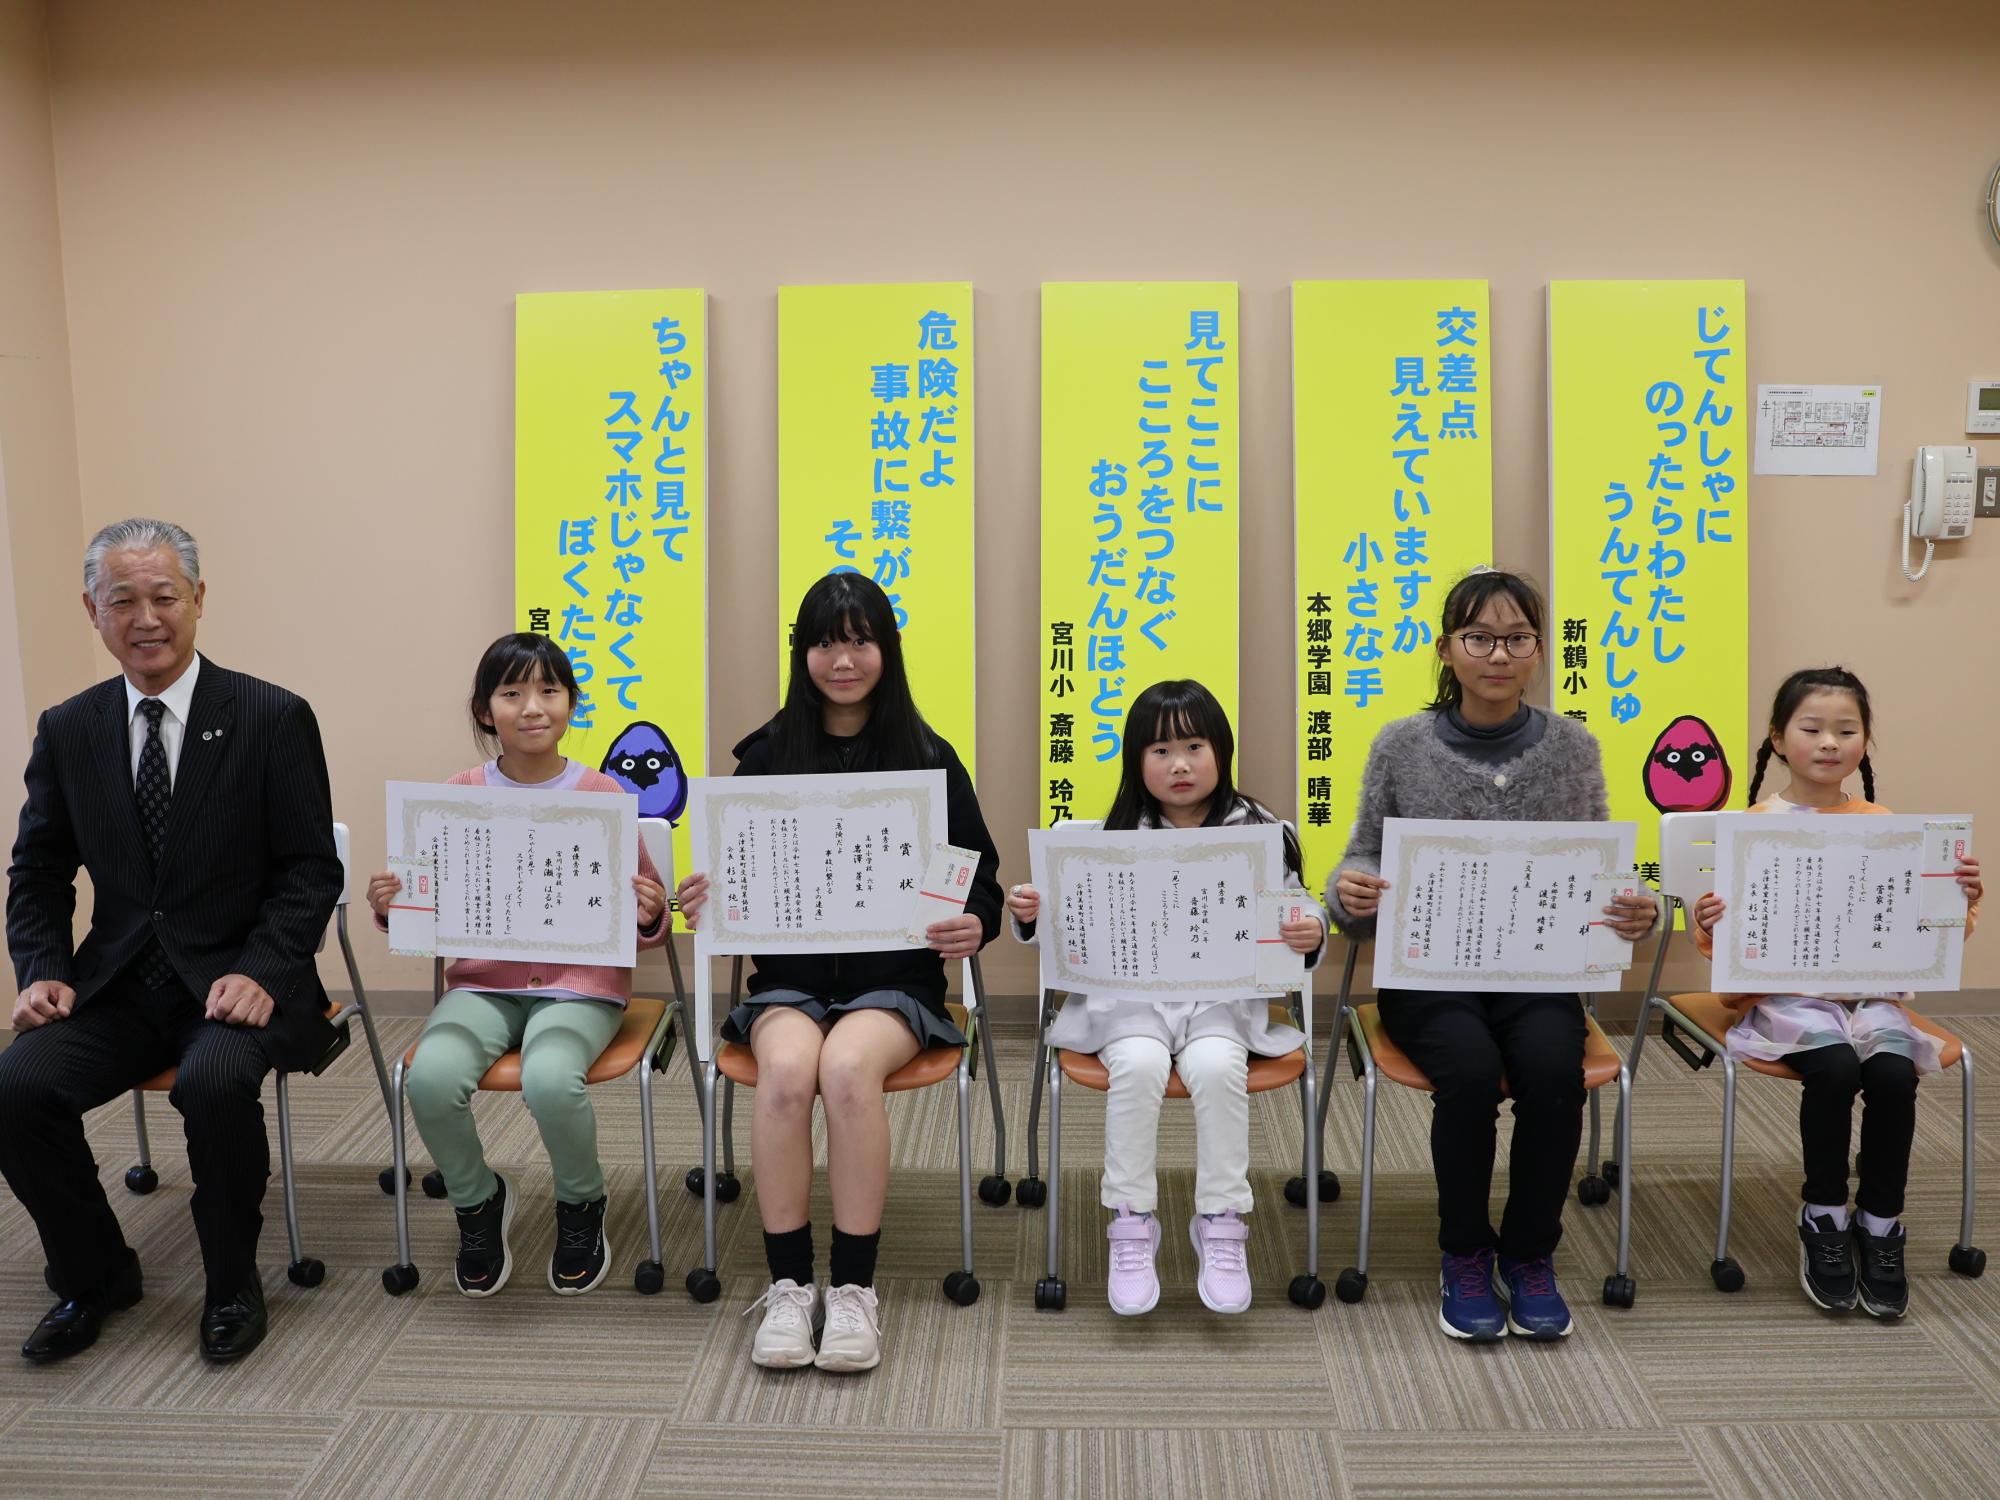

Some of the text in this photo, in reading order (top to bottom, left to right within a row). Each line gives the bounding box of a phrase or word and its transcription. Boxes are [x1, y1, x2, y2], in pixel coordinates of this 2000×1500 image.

[1436, 306, 1478, 440] 交差点
[916, 309, 959, 488] 危険だよ
[1184, 310, 1226, 514] 見てここに
[650, 316, 692, 562] ちゃんと見て
[1692, 306, 1736, 544] じてんしゃに
[1133, 360, 1176, 652] こころをつなぐ
[1388, 356, 1433, 655] 見えていますか
[1644, 380, 1688, 664] のったらわたし
[602, 390, 646, 712] スマホじゃなくて
[824, 518, 862, 575] そ
[1086, 458, 1130, 764] おうだんほどう
[1343, 532, 1384, 709] 小さな手
[1599, 481, 1642, 724] うんてんしゅ
[1562, 618, 1588, 695] 新鶴小
[1048, 621, 1074, 828] 宮川小 斎藤 玲乃
[1306, 592, 1332, 828] 本郷学園 渡部 晴華
[881, 826, 890, 852] 優秀賞
[572, 844, 580, 877] 最優秀賞
[726, 866, 736, 884] 杉山
[824, 849, 834, 894] 事故に繋がる
[544, 886, 552, 910] はるか
[728, 893, 739, 908] 純一
[866, 877, 874, 892] 六年
[1172, 870, 1180, 909] 「見てここに
[1217, 880, 1226, 904] 優秀賞
[1550, 881, 1558, 910] 本郷学園
[1568, 874, 1576, 899] 優秀賞
[1847, 874, 1855, 924] のったらわたし
[1876, 885, 1884, 905] 菅家
[1886, 876, 1895, 914] 新鶴小学校
[1904, 870, 1912, 895] 優秀賞
[544, 918, 554, 926] 殿
[854, 900, 866, 909] 殿
[1066, 914, 1075, 931] 杉山
[1161, 890, 1169, 937] こころをつなぐ
[1200, 887, 1209, 924] 宮川小学校
[1412, 905, 1422, 922] 杉山
[1508, 885, 1519, 935] 見えていますか
[1534, 889, 1548, 951] 渡部 晴華 殿
[1748, 903, 1758, 922] 杉山
[1068, 939, 1078, 953] 純一
[1189, 924, 1200, 943] 玲乃
[1410, 931, 1421, 946] 純一
[1747, 930, 1758, 946] 純一
[1872, 941, 1882, 950] 殿
